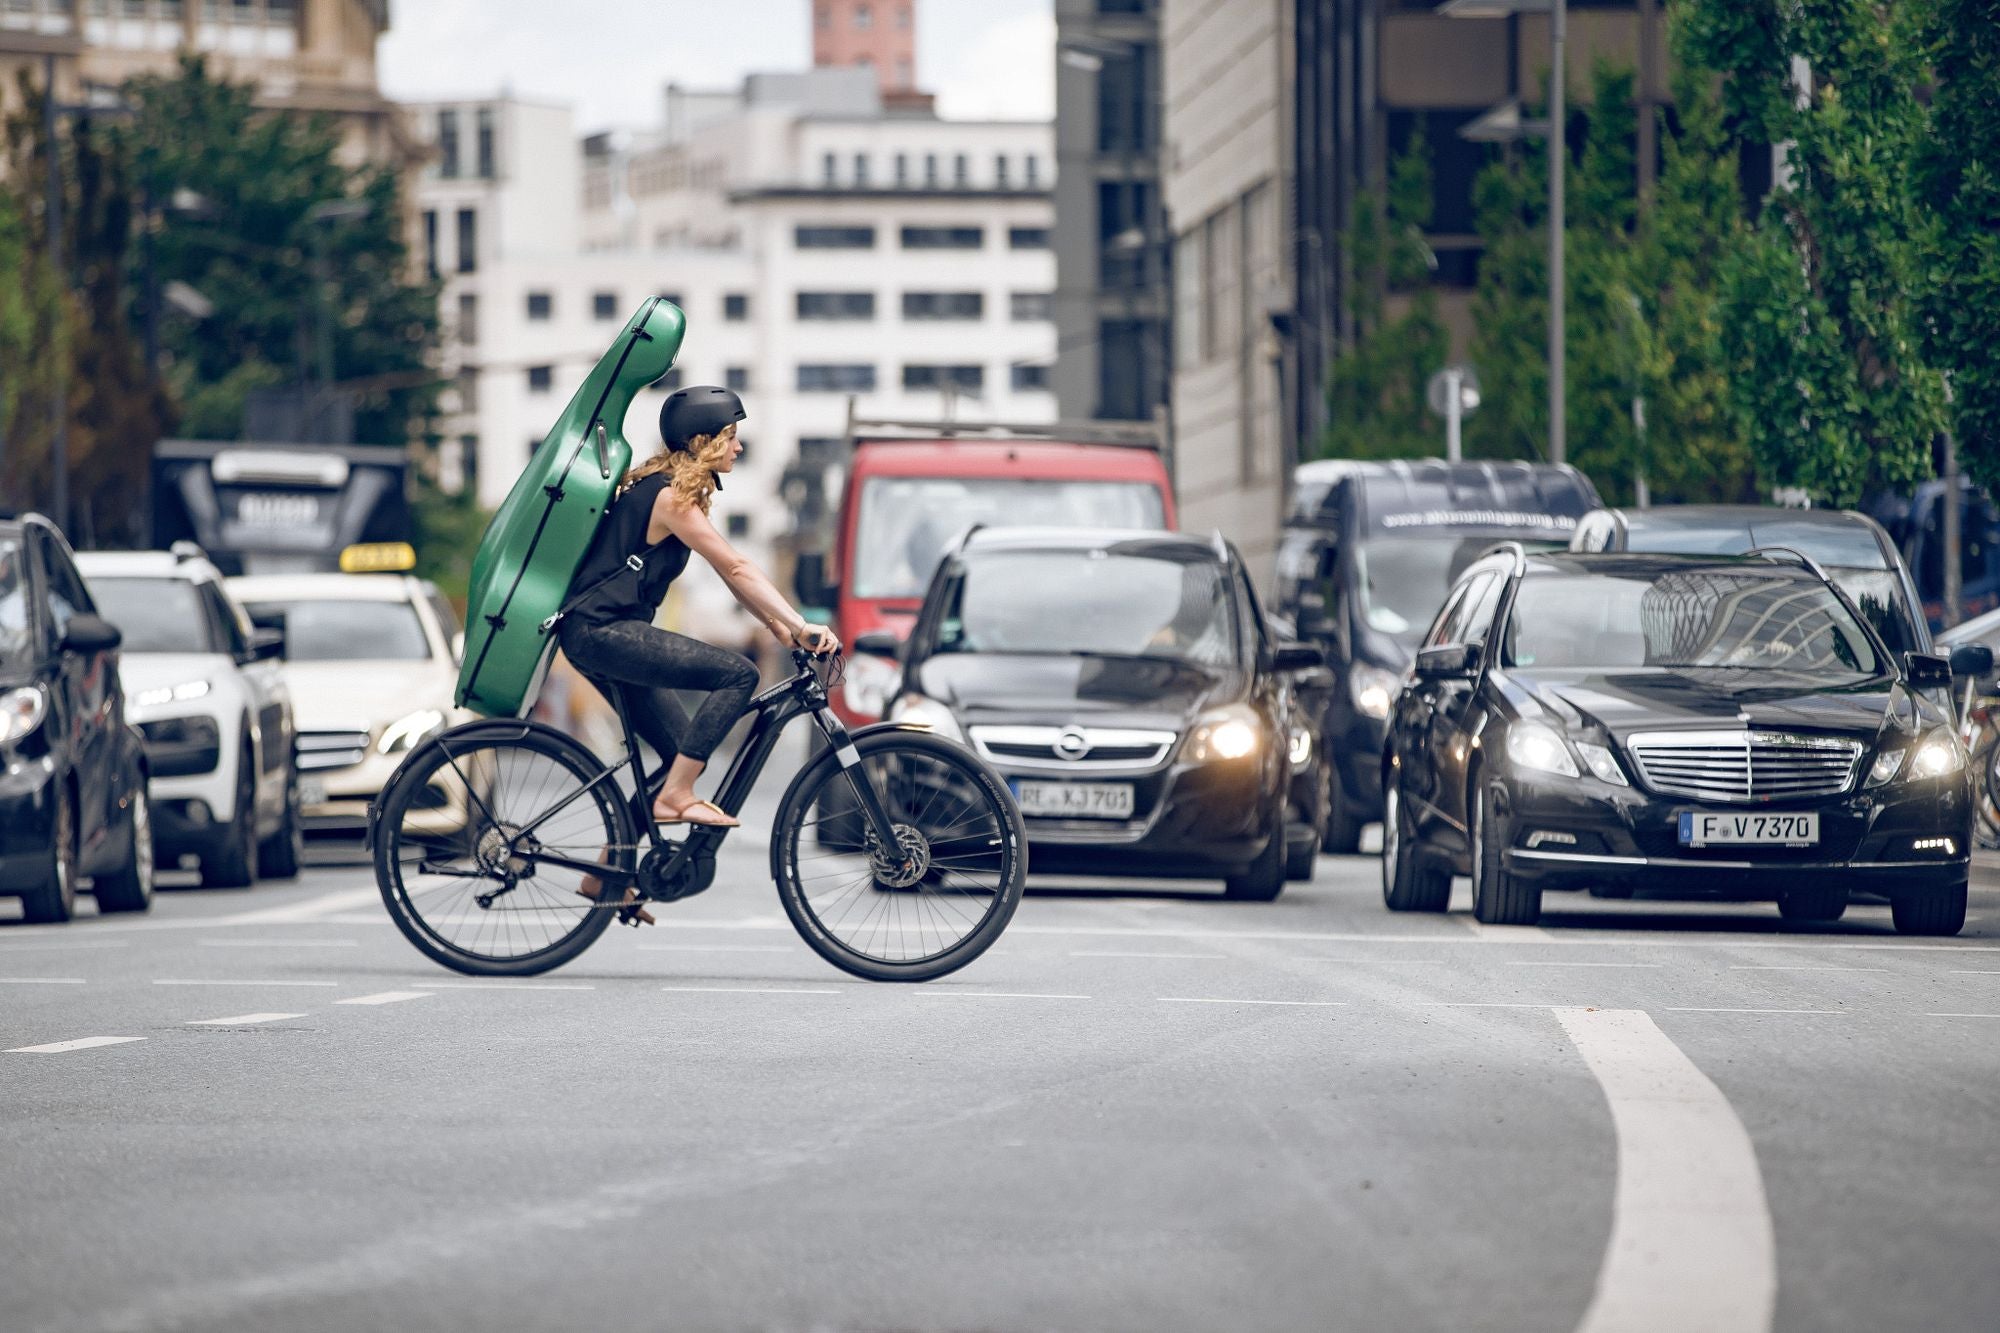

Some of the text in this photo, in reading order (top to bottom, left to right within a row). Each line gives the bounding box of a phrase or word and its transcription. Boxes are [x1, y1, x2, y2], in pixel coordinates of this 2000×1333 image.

[979, 772, 1014, 832] SCHWALBE
[1022, 788, 1043, 806] RE
[1703, 817, 1809, 838] F V 7370
